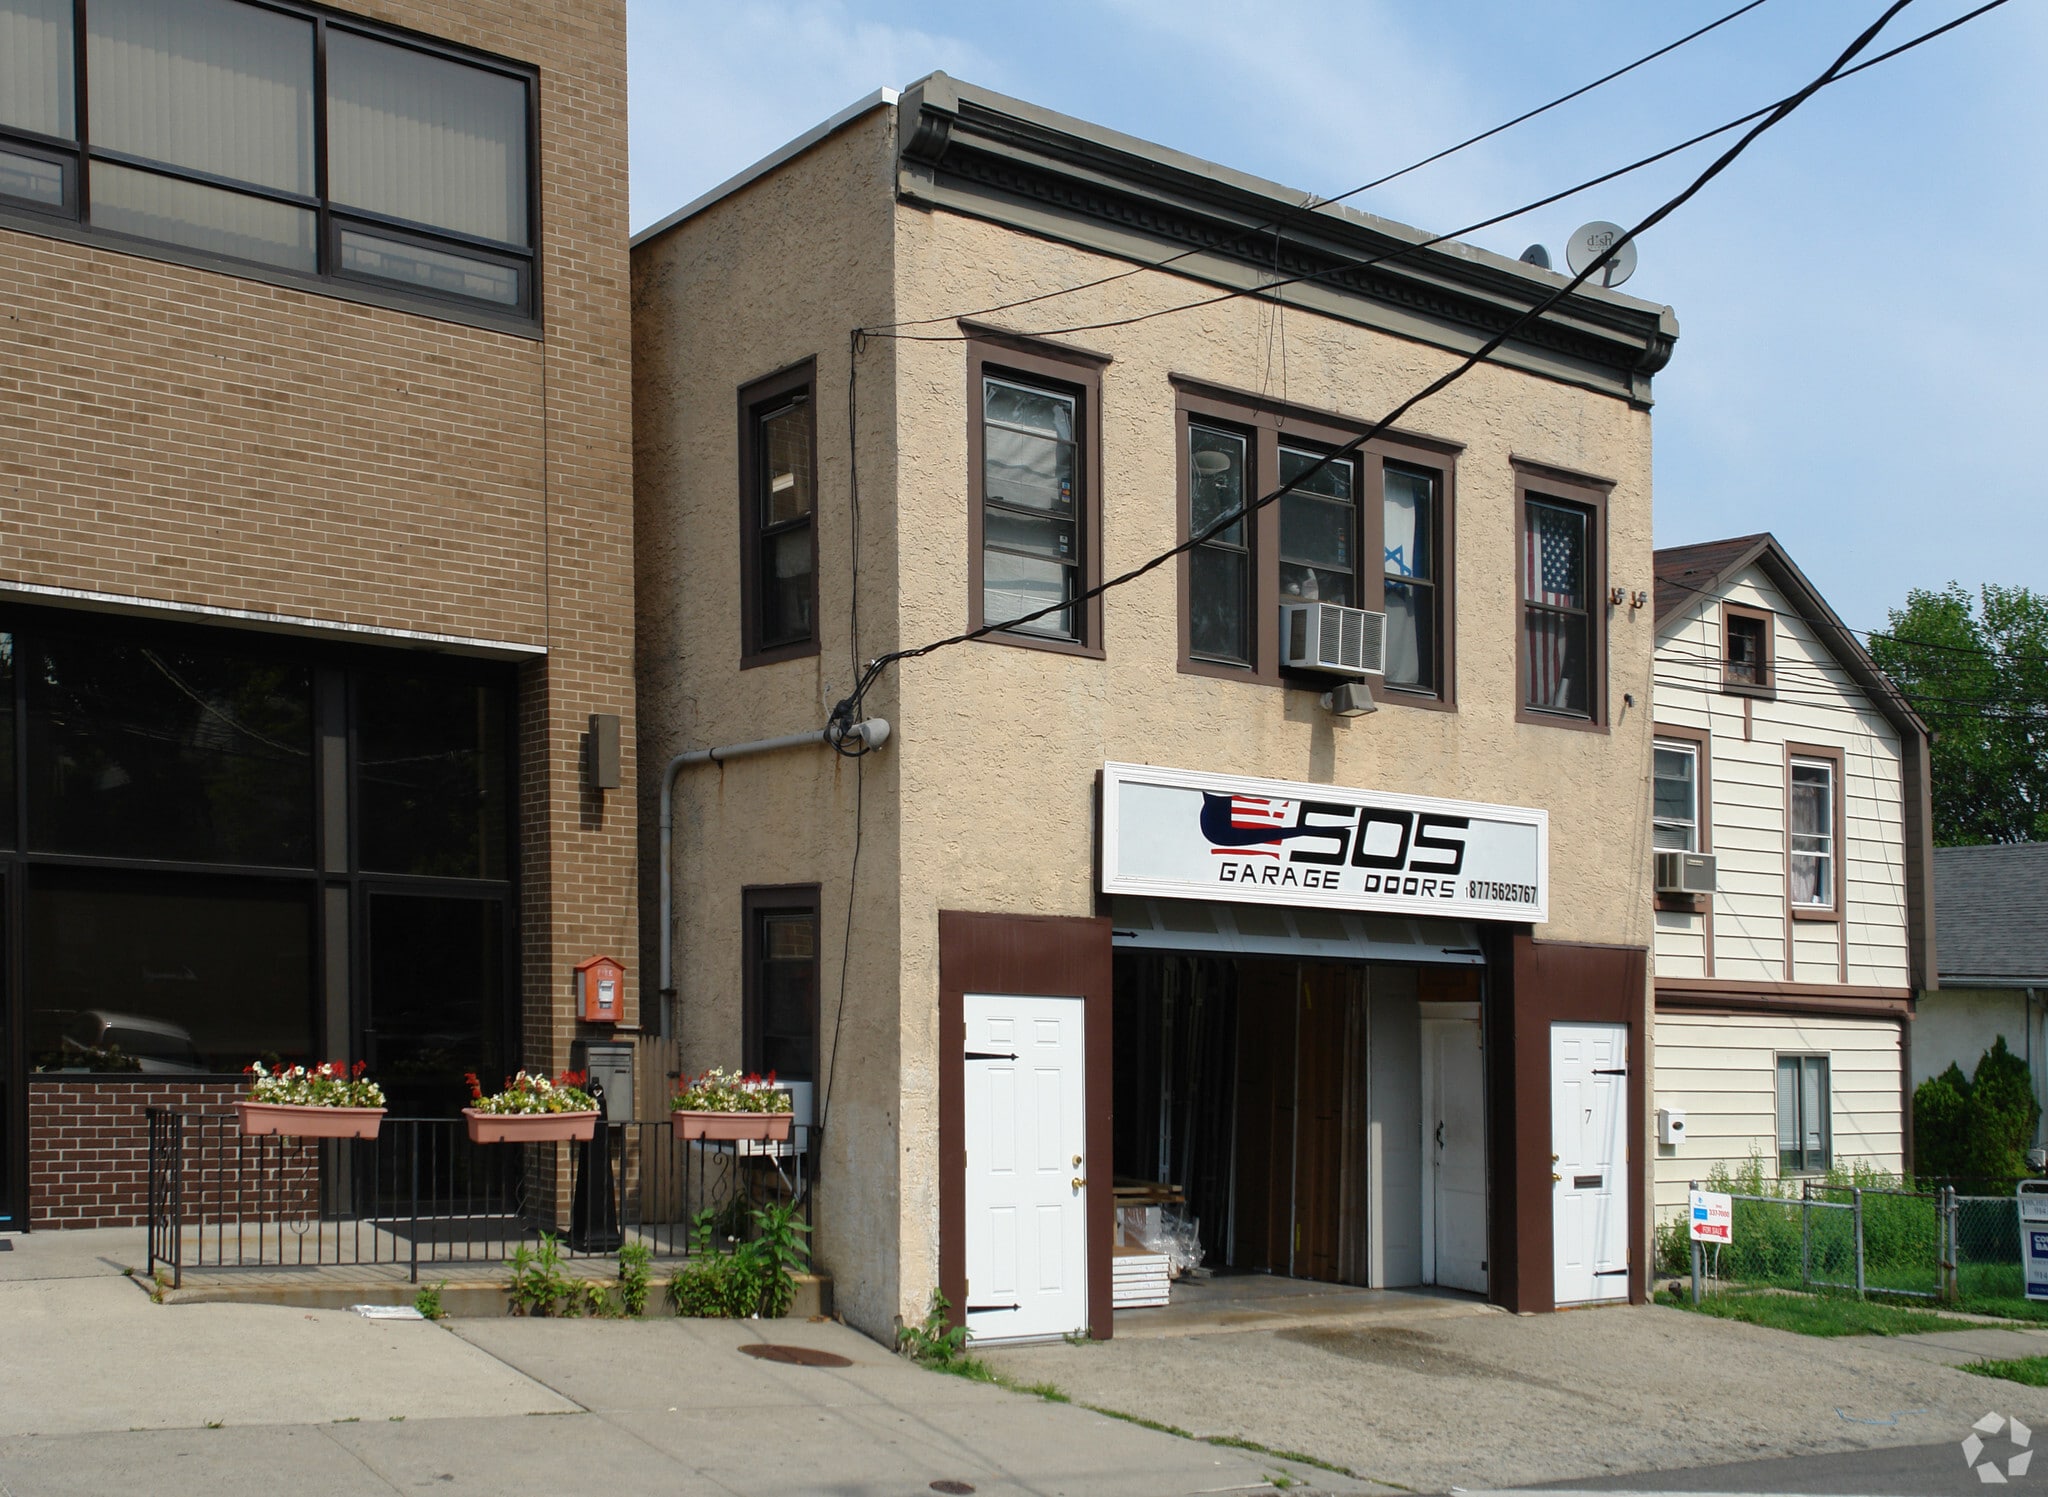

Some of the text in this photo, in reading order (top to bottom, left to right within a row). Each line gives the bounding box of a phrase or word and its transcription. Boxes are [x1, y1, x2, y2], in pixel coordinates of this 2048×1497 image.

[1587, 234, 1612, 246] dish
[1289, 801, 1470, 875] SOS
[1219, 862, 1341, 889] GARAGE
[1364, 874, 1456, 898] DOORS
[1585, 1109, 1592, 1124] 7
[1702, 1226, 1722, 1235] FOR SALE
